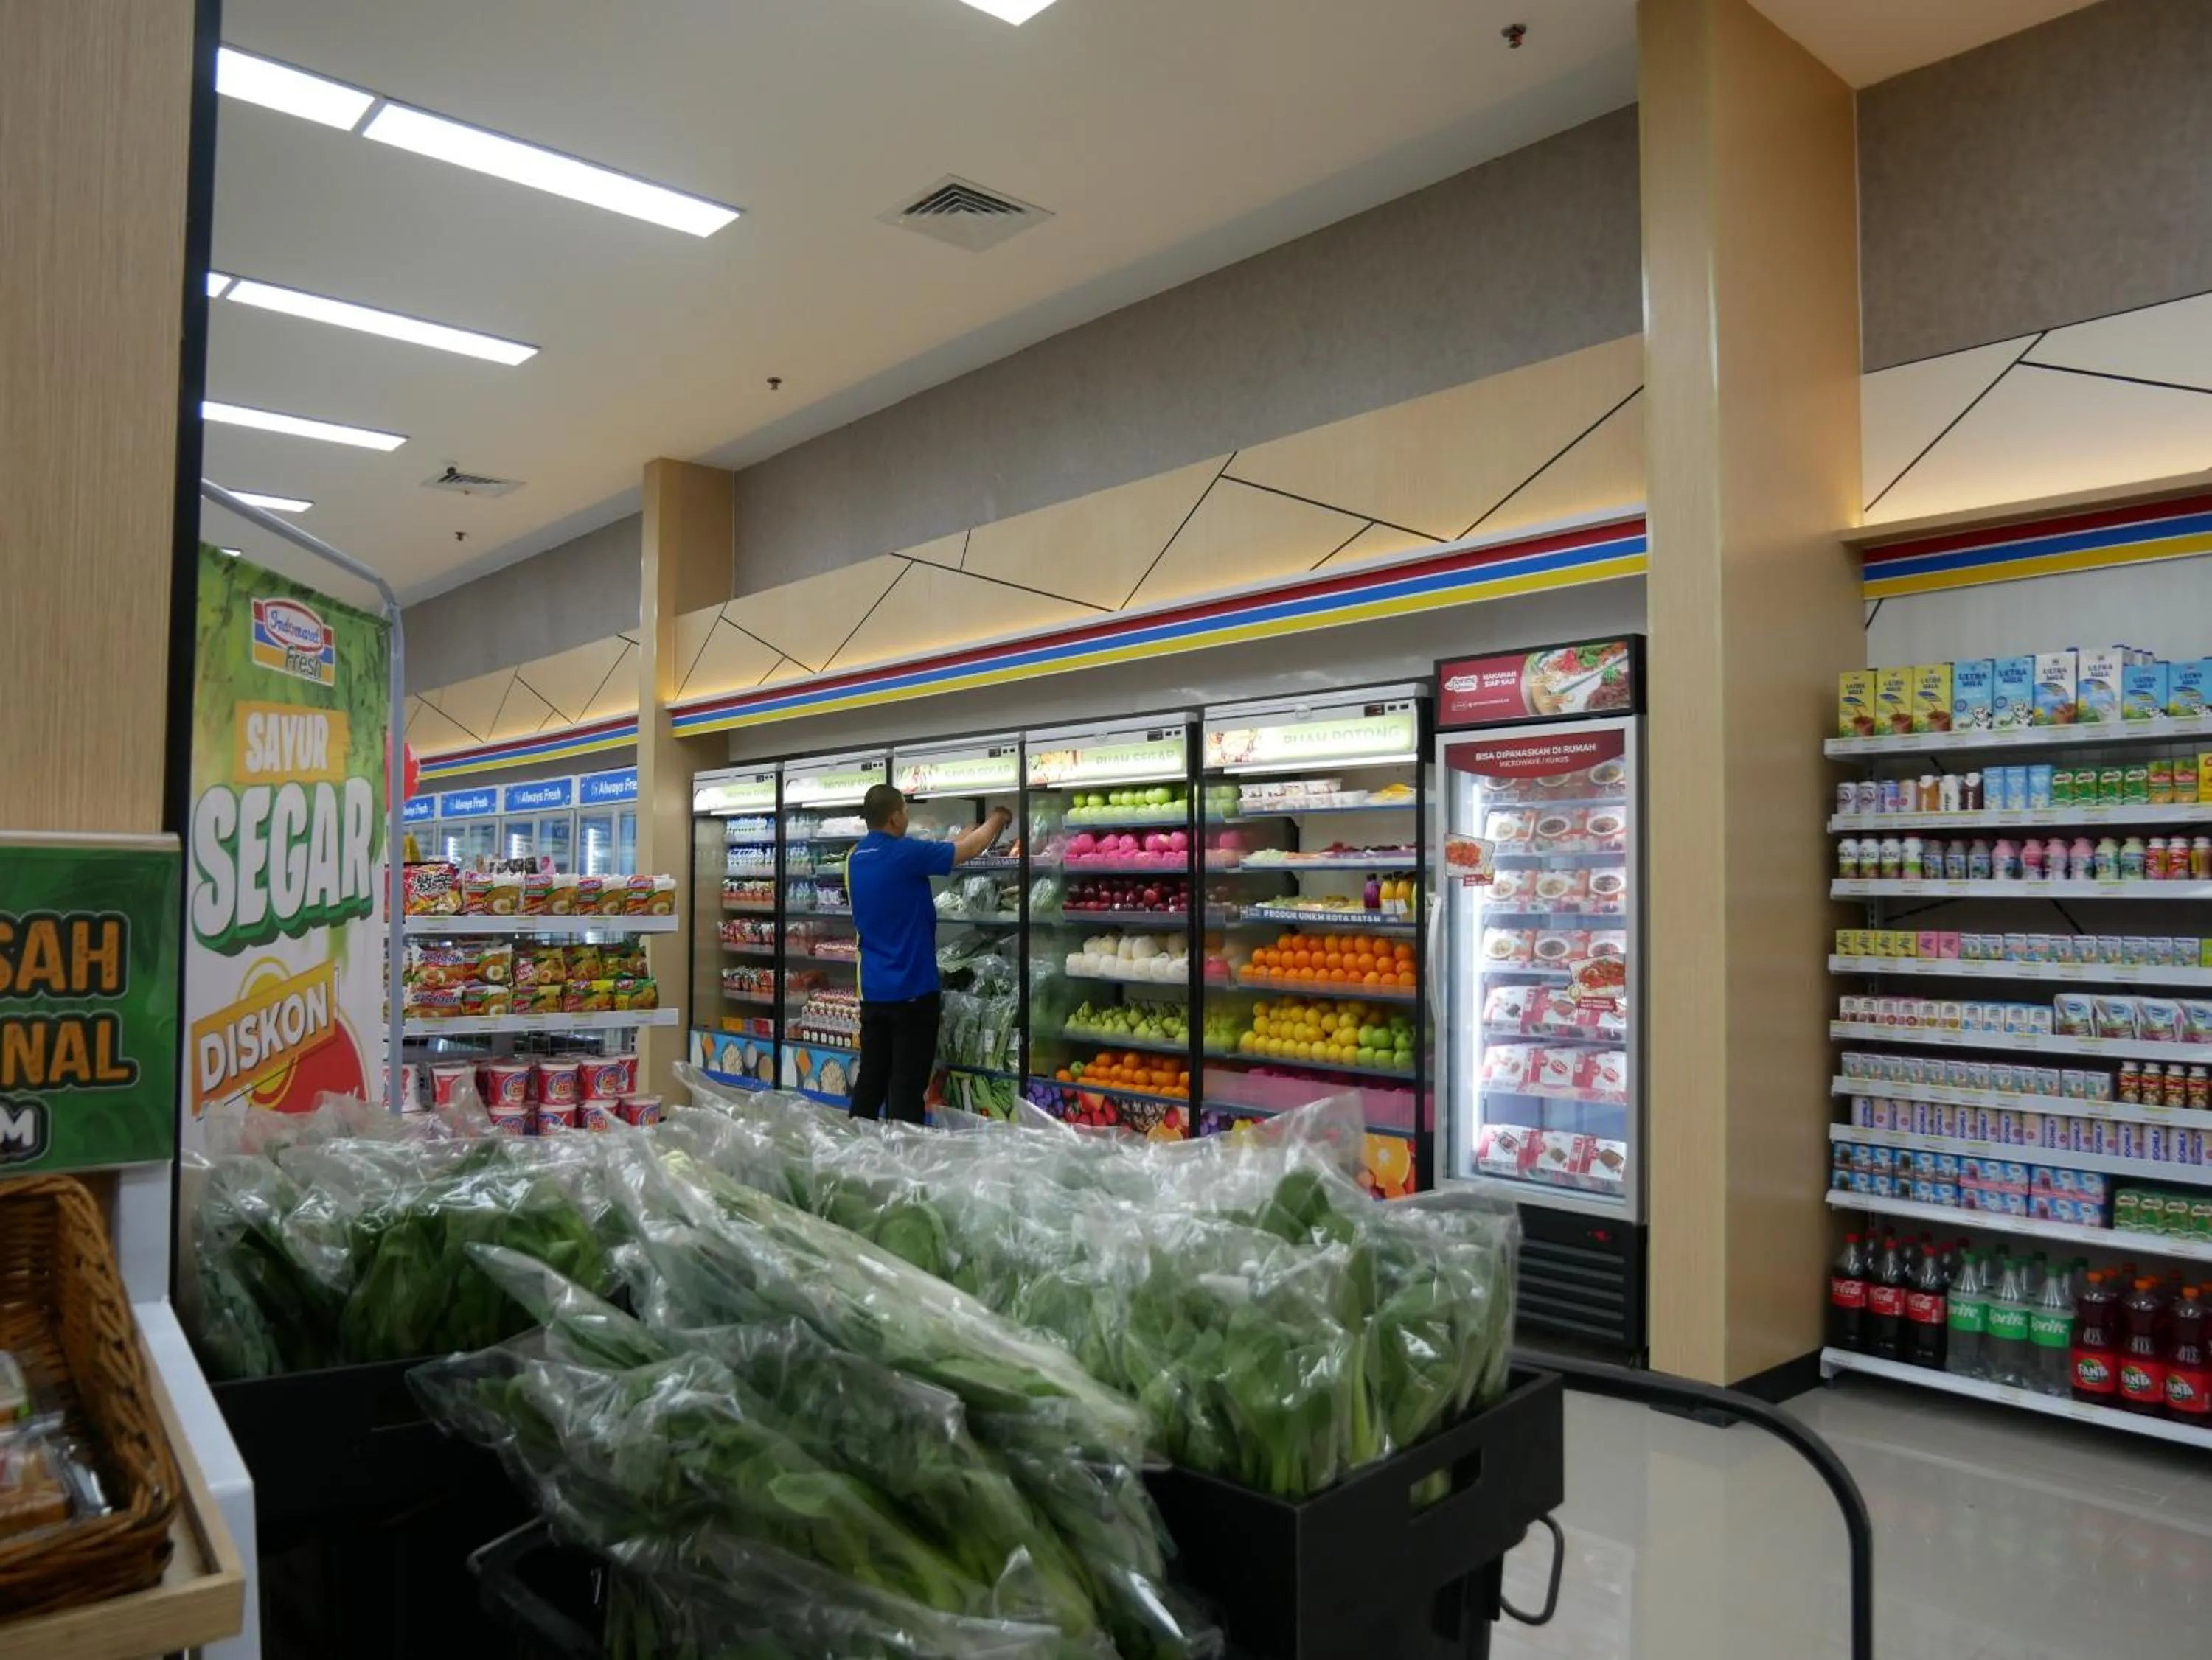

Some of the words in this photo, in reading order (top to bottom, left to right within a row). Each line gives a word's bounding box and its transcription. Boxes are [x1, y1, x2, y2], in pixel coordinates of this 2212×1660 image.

[270, 610, 320, 643] Indomaret
[285, 646, 322, 681] Fresh
[246, 712, 329, 773] SAYUR
[1476, 752, 1495, 761] BISA
[1496, 747, 1551, 759] DIPANASKAN
[1552, 745, 1561, 753] DI
[1563, 743, 1596, 753] RUMAH
[521, 791, 543, 804] Always
[545, 788, 562, 801] Fresh
[599, 781, 624, 796] Always
[625, 778, 638, 791] Fre
[473, 797, 488, 808] Fresh
[192, 775, 374, 940] SEGAR
[1263, 909, 1298, 919] PRODUK
[1326, 912, 1349, 921] KOTA
[1350, 913, 1382, 922] BATAM
[198, 980, 330, 1094] DISKON
[2078, 1362, 2110, 1380] FANTA
